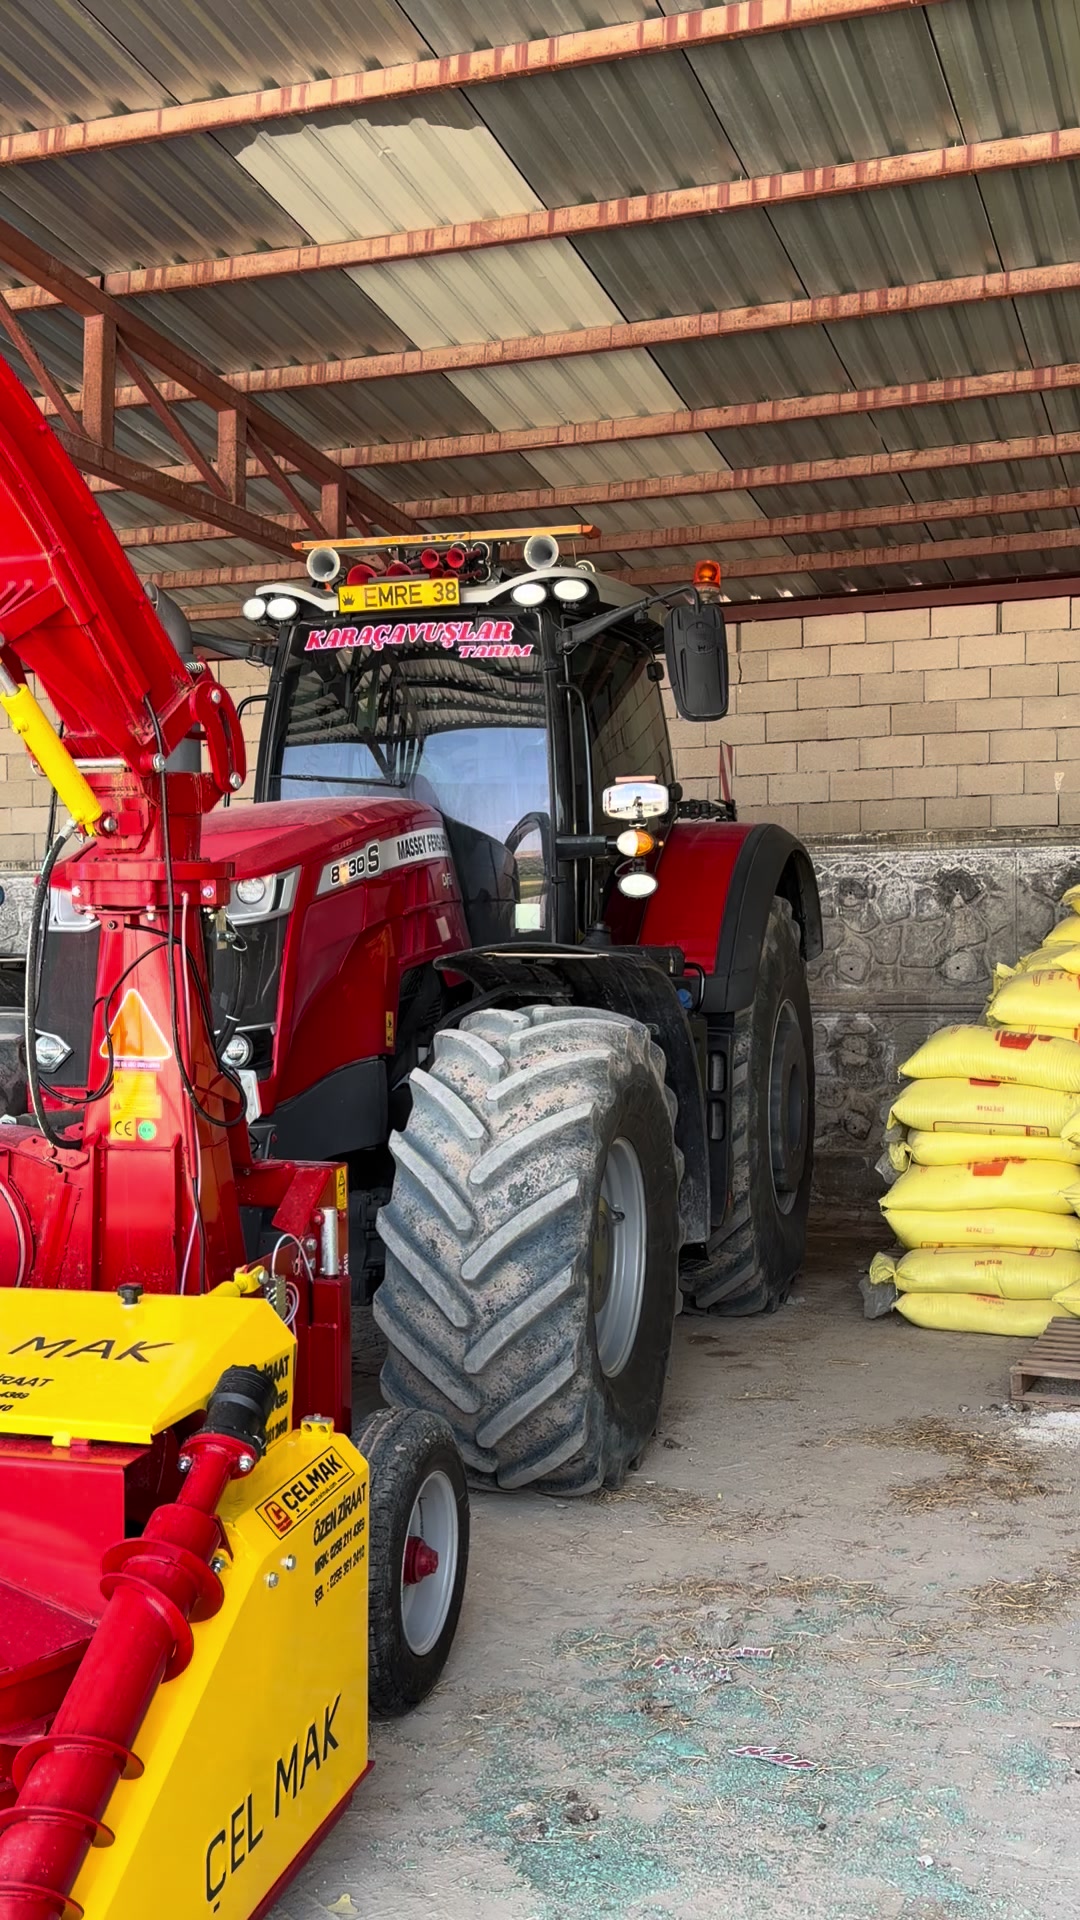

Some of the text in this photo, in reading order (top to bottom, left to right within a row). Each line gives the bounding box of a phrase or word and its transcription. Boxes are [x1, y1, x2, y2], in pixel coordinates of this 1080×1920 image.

[363, 581, 457, 608] EMRE 38
[304, 621, 514, 650] KARAÇAVUŞLAR
[459, 644, 534, 658] TARIM
[397, 834, 426, 861] MASSEY
[8, 1336, 175, 1363] MAK
[281, 1454, 343, 1513] ÇELMAK
[313, 1482, 367, 1546] ÖZEN ZİRAAT
[206, 1692, 342, 1913] ÇEL MAK
